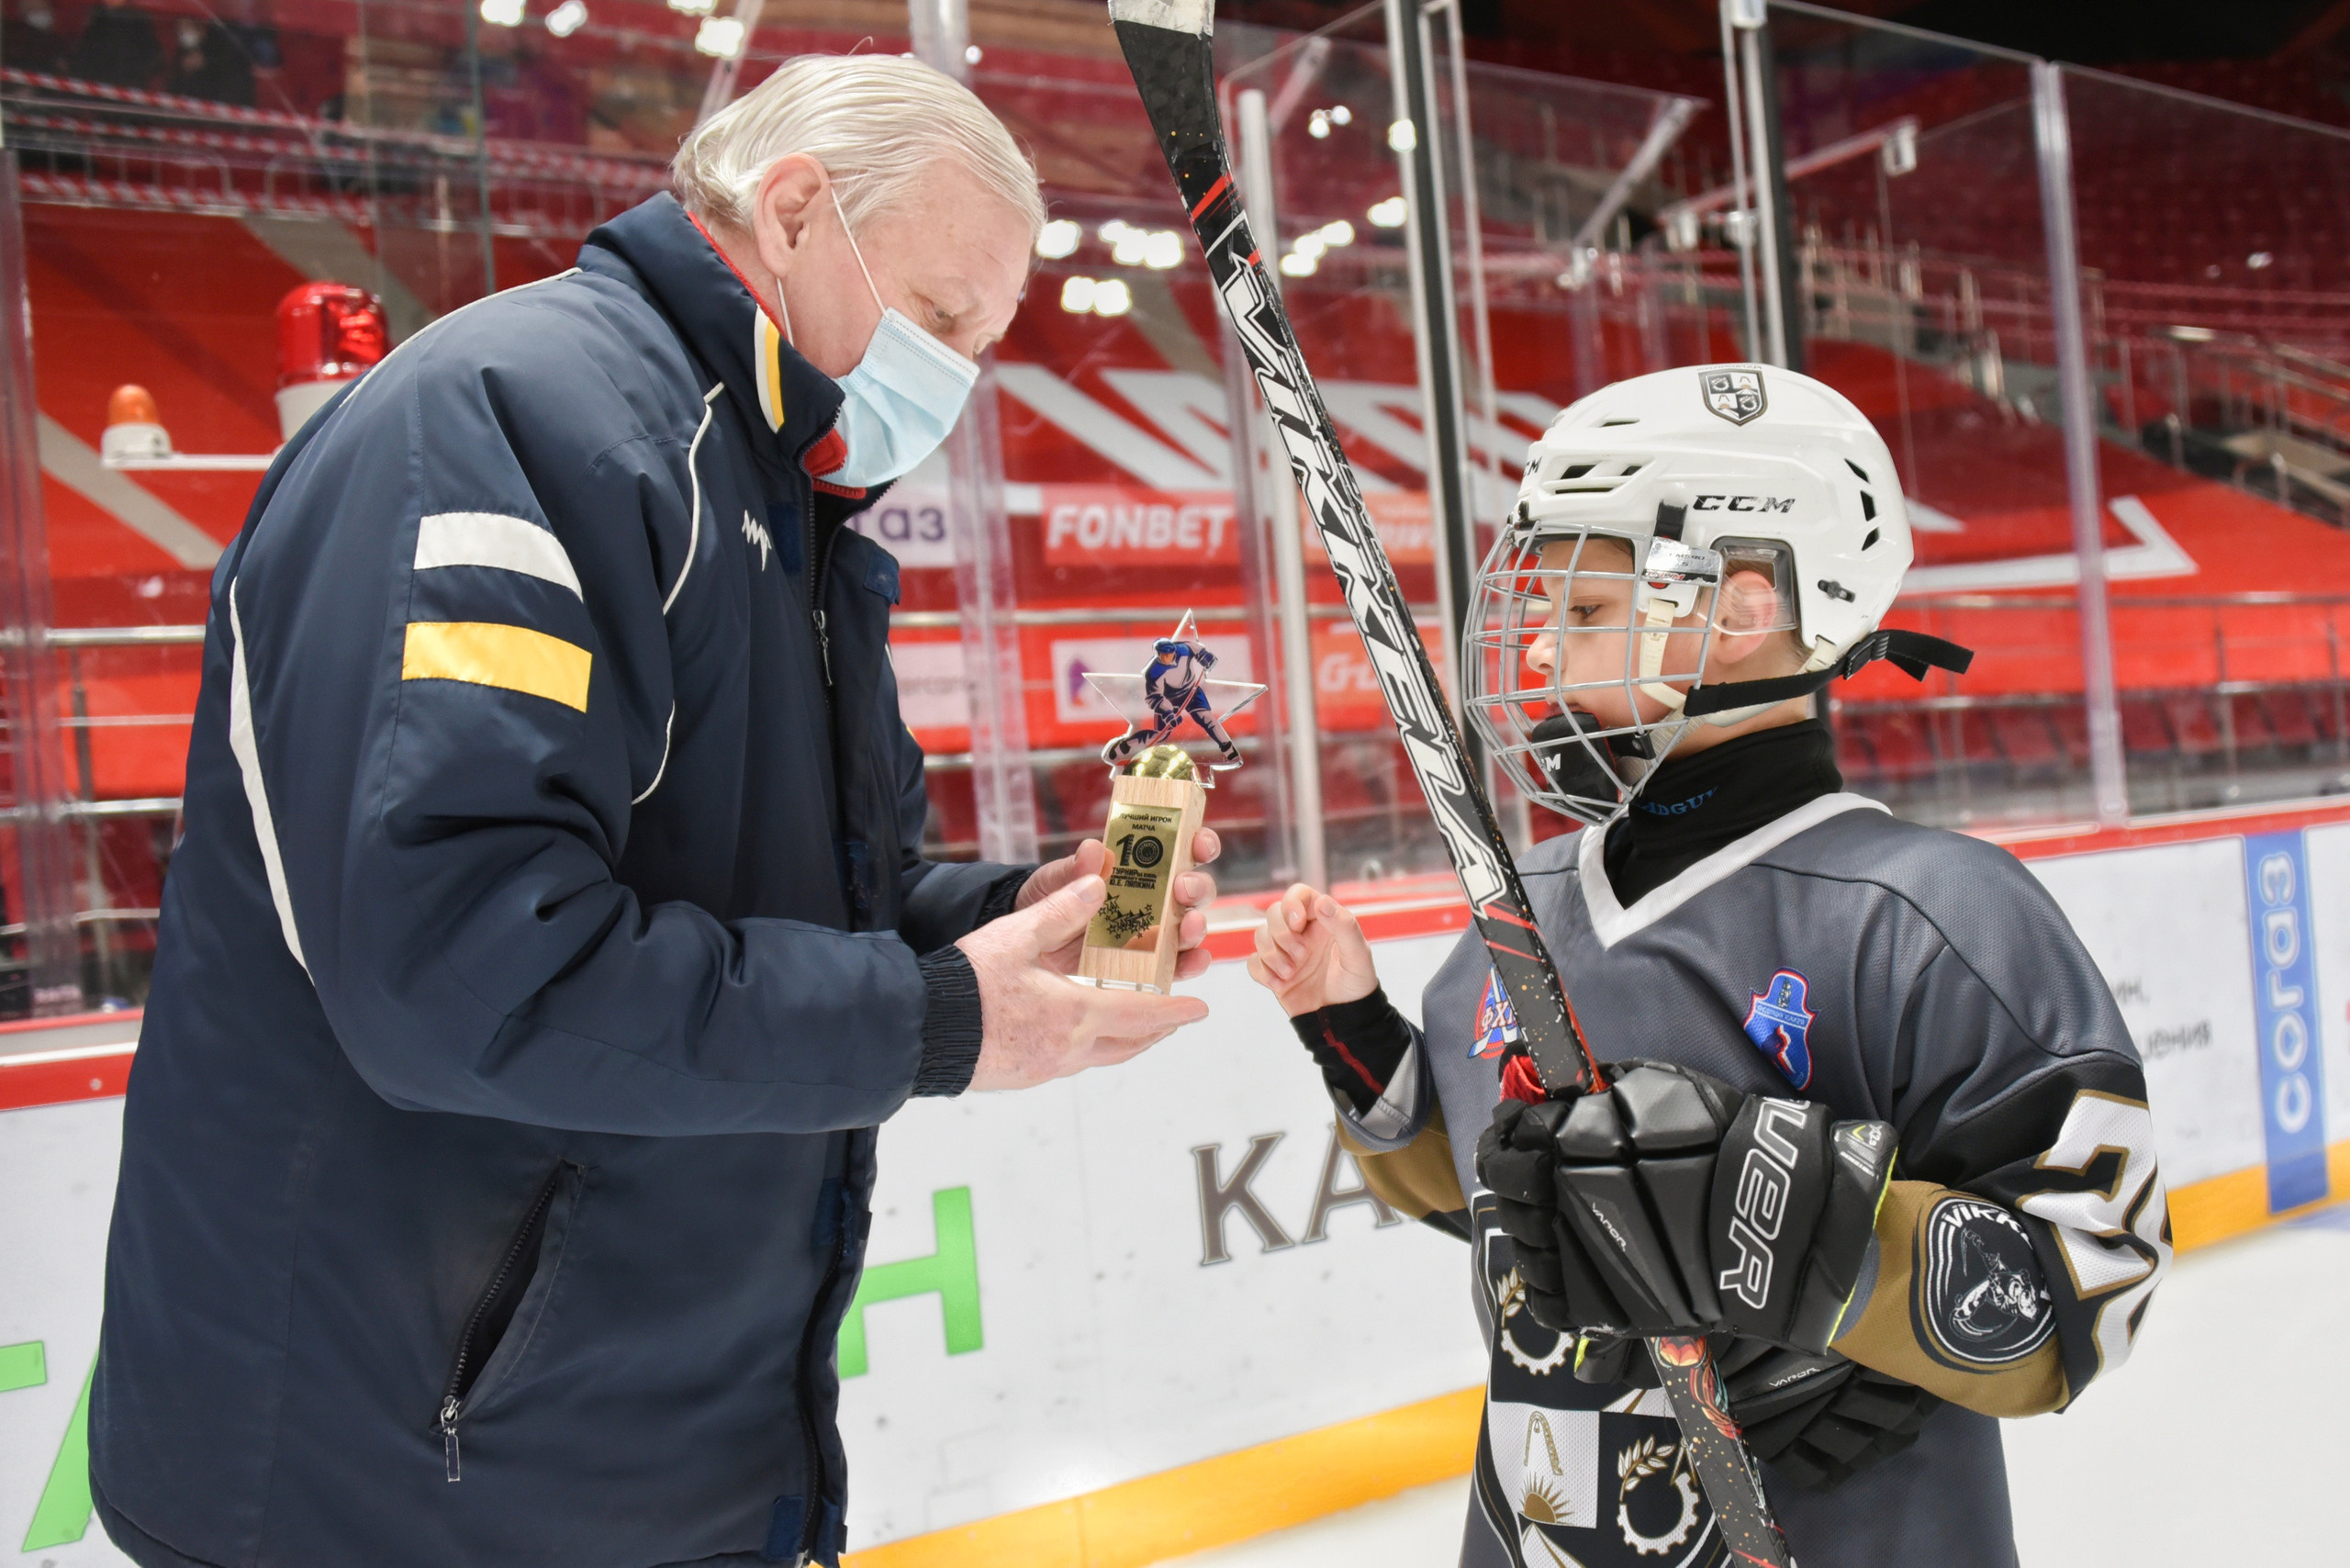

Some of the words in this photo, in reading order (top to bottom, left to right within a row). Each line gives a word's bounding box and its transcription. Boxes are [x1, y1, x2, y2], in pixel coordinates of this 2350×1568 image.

[1693, 495, 1796, 513] CCM
[1047, 504, 1236, 554] FONBET
[1222, 253, 1507, 920] VIKKELA
[1119, 812, 1149, 822] ЛУЧШИЙ
[1150, 815, 1172, 823] ИГРОК
[1632, 784, 1719, 817] ADGUY
[1132, 823, 1156, 832] МАТЧА
[1115, 833, 1164, 869] 10
[1719, 1095, 1812, 1310] UER
[1591, 1201, 1627, 1253] VAPOR
[1768, 1366, 1821, 1387] VAPOR
